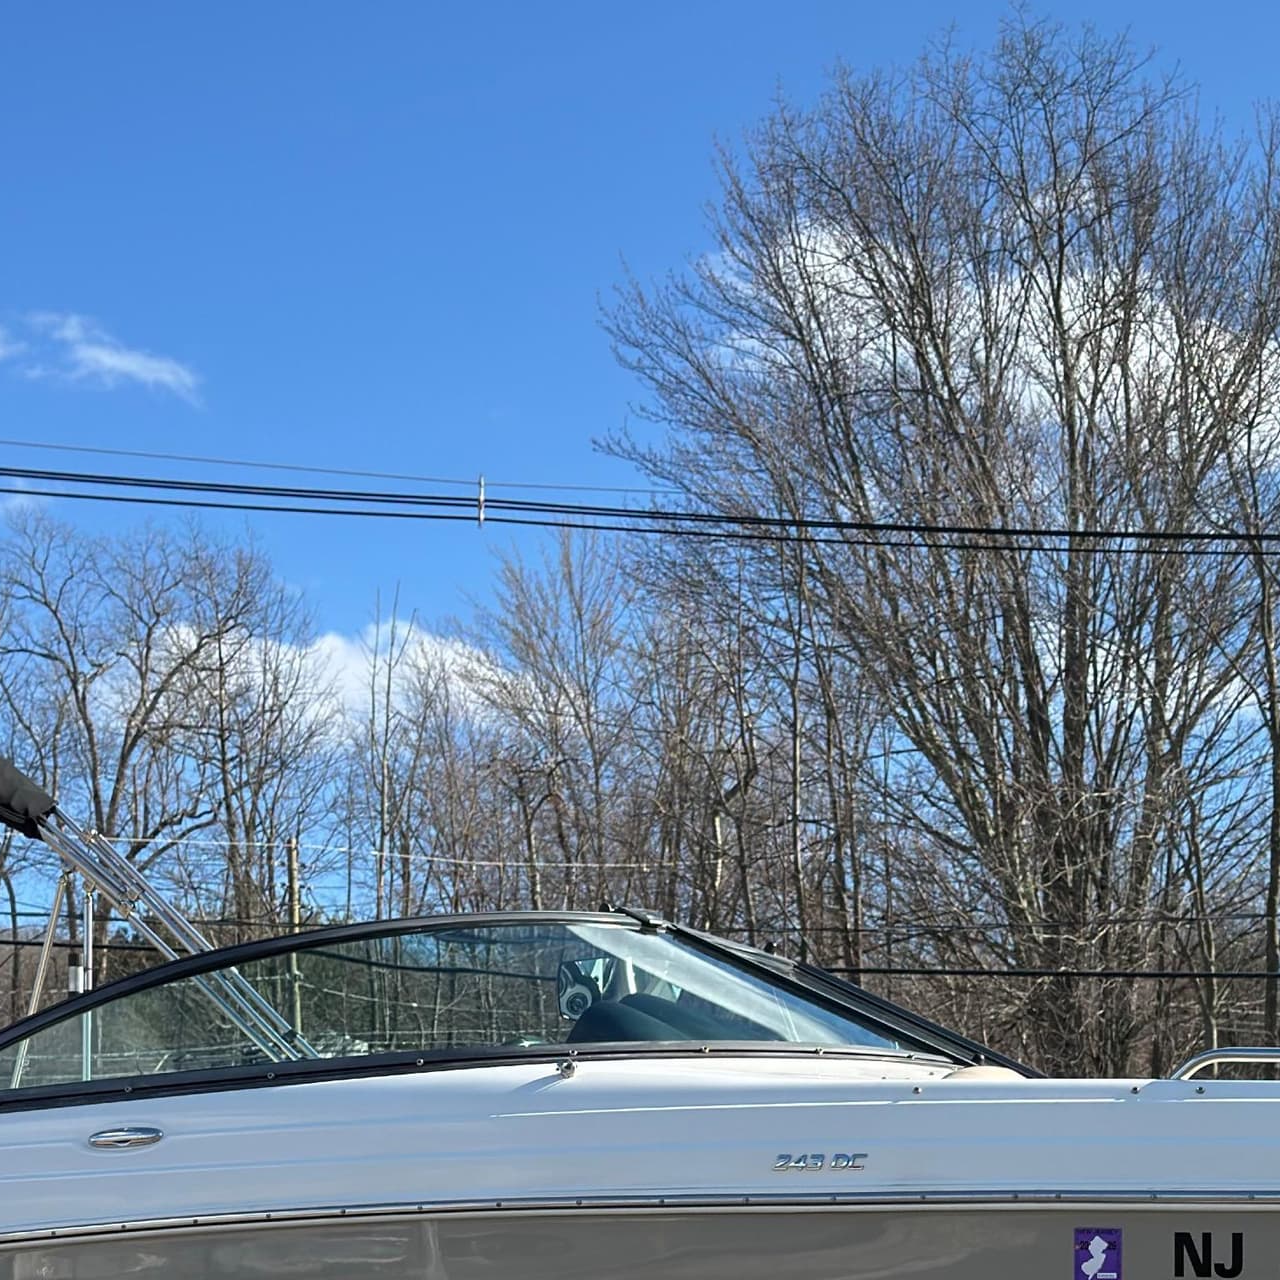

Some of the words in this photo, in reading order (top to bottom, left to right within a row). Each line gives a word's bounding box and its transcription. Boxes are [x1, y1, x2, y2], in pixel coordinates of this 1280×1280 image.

[772, 1153, 826, 1171] 243
[830, 1153, 868, 1171] DC
[1174, 1231, 1244, 1279] NJ
